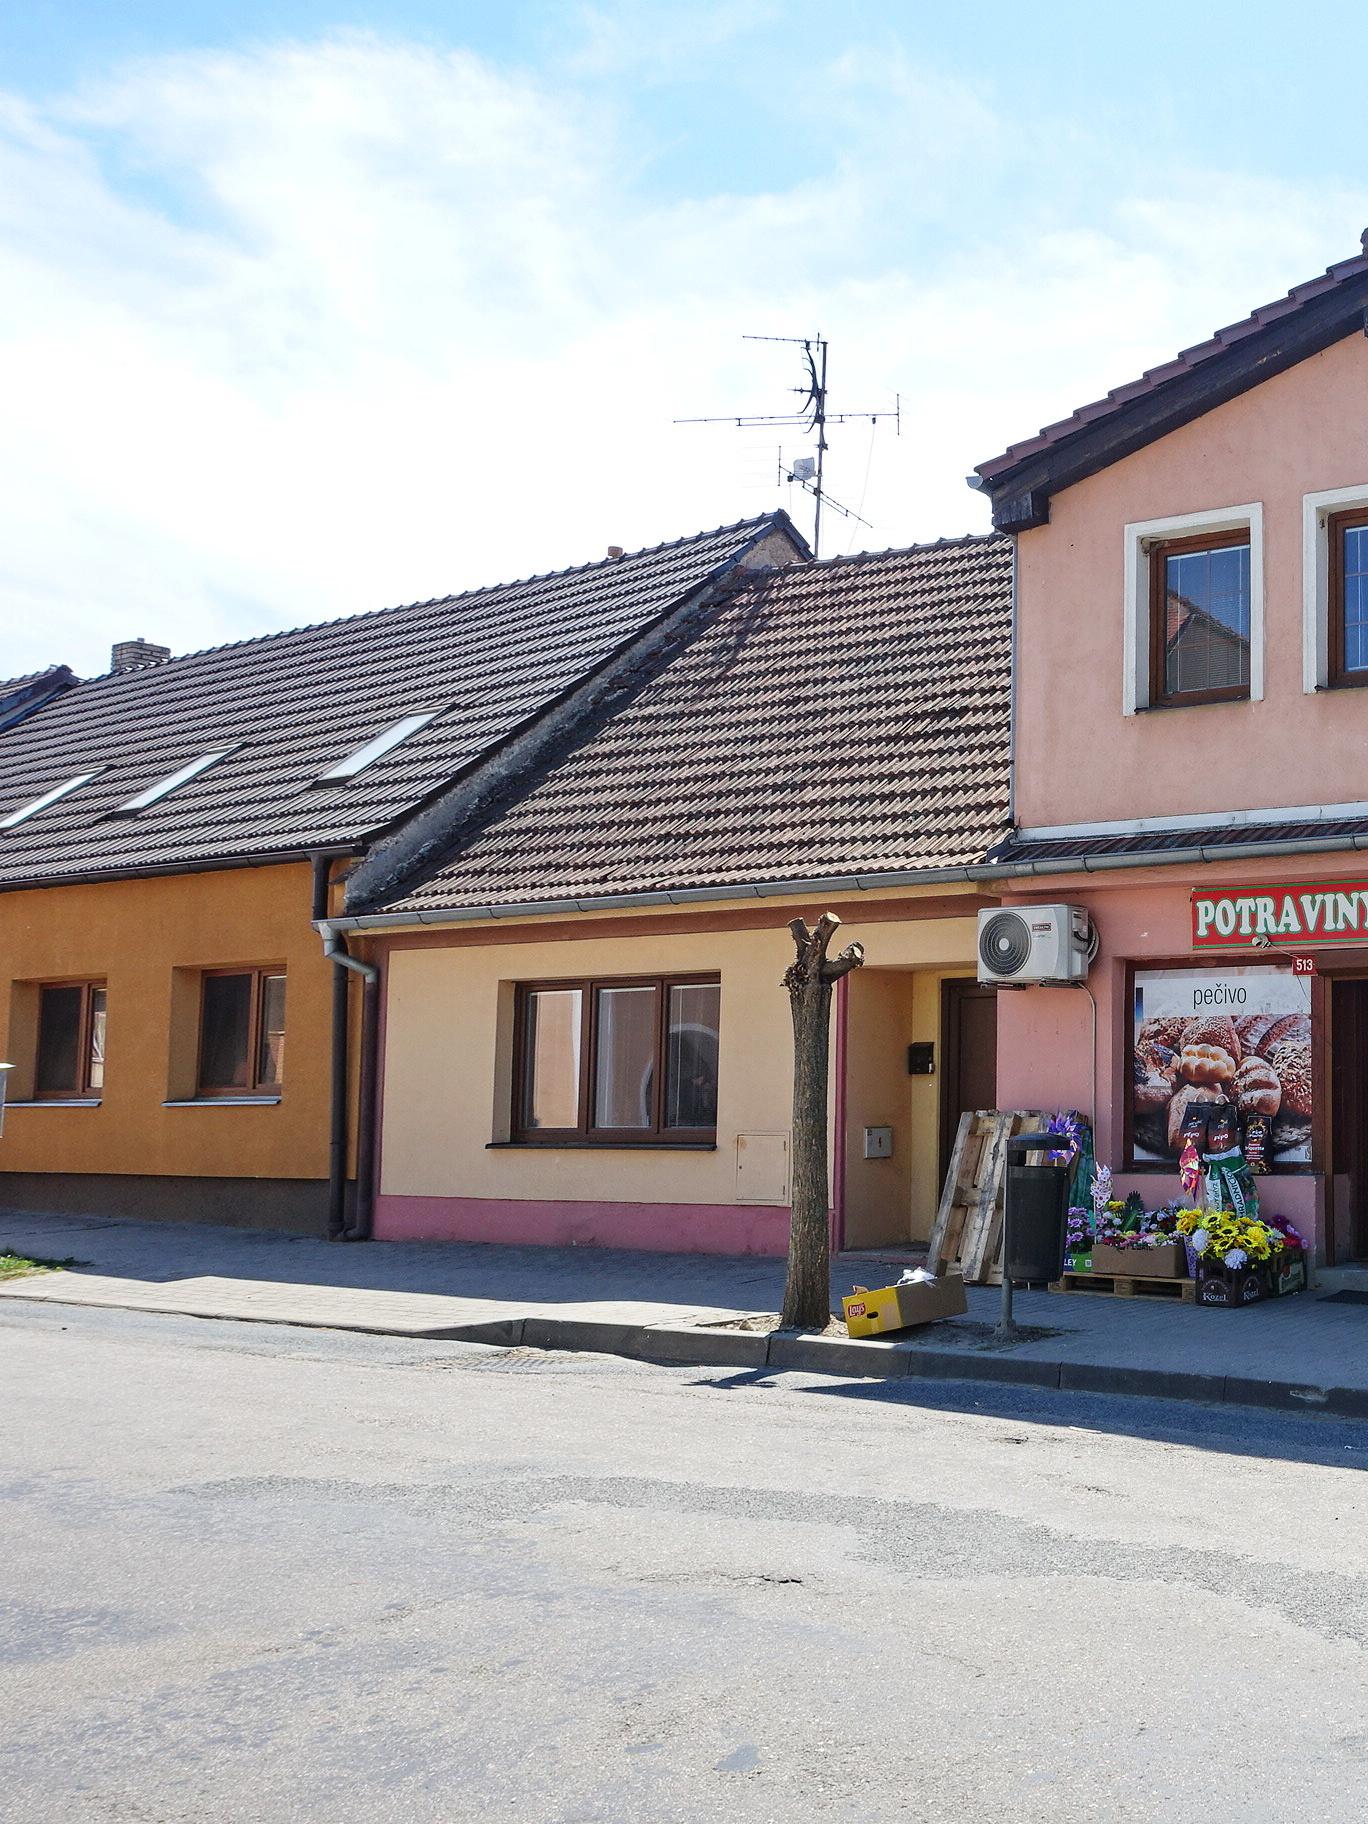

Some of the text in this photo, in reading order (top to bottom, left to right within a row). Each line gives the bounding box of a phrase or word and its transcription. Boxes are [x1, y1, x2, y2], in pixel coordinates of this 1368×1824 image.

[1296, 958, 1313, 971] 513
[1193, 983, 1247, 1010] pečivo
[1203, 1292, 1227, 1302] Kozel
